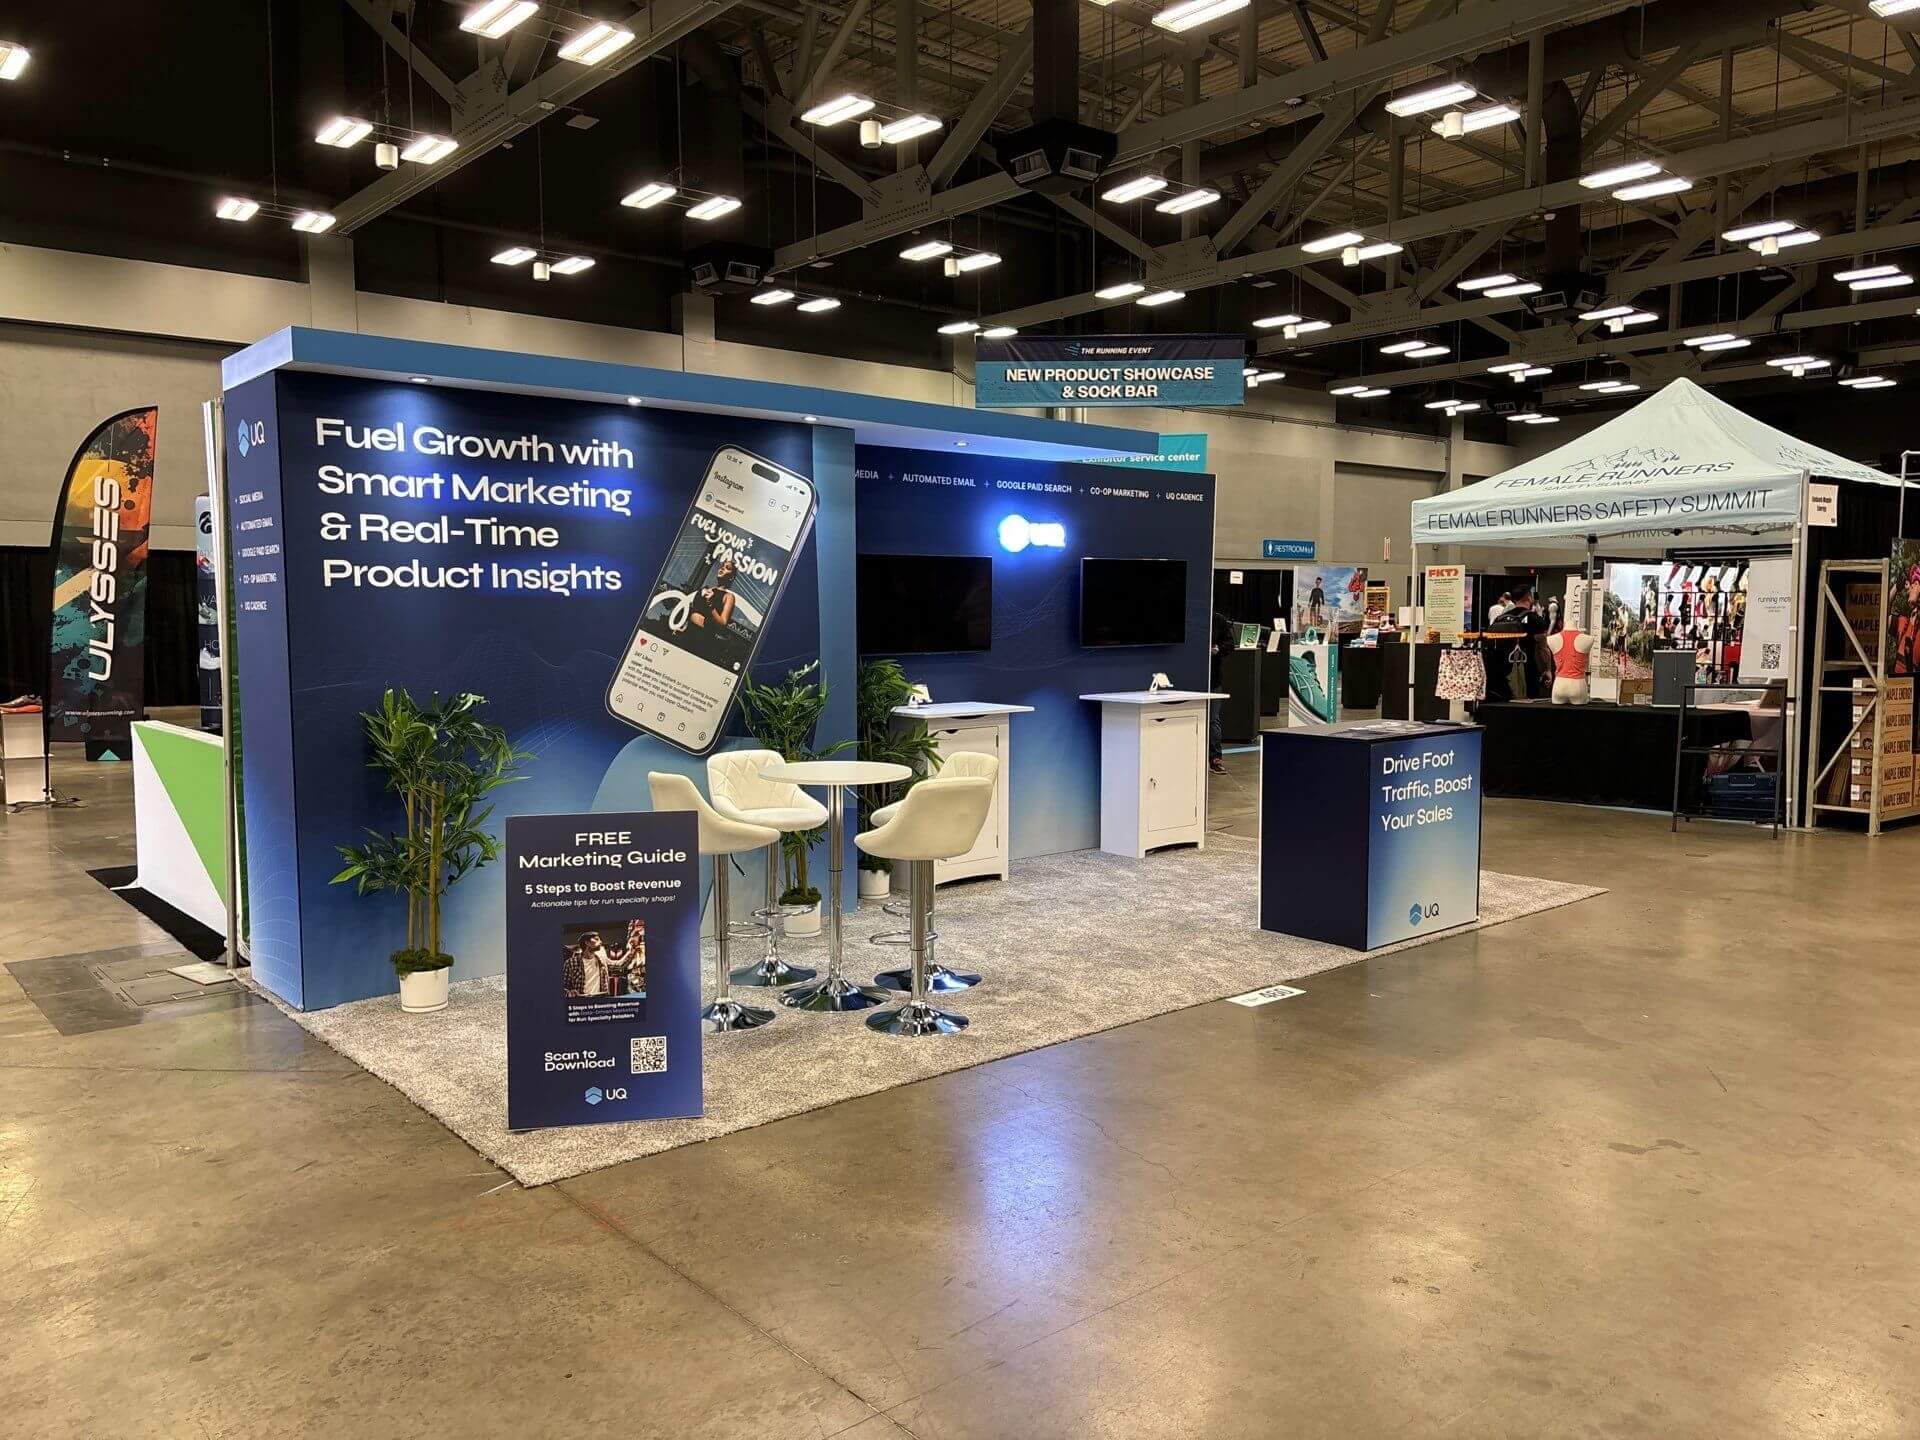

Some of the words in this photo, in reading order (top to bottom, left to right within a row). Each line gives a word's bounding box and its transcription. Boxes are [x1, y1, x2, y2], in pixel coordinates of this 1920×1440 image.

[1006, 369, 1043, 382] NEW
[1044, 368, 1120, 381] PRODUCT
[1123, 367, 1214, 380] SHOWCASE
[1063, 386, 1074, 398] &
[1077, 385, 1122, 398] SOCK
[1125, 385, 1158, 397] BAR
[250, 420, 266, 447] UQ
[316, 417, 405, 453] Fuel
[413, 426, 554, 463] Growth
[560, 438, 633, 469] with
[1167, 453, 1200, 462] center
[902, 473, 952, 485] AUTOMATED
[953, 477, 976, 487] EMAIL
[1494, 472, 1596, 489] FEMALE
[1597, 462, 1735, 482] RUNNERS
[317, 465, 445, 500] Smart
[453, 475, 632, 516] Marketing
[996, 480, 1026, 490] GOOGLE
[1027, 482, 1044, 491] PAID
[1044, 484, 1072, 493] SEARCH
[1090, 486, 1112, 495] CO-OP
[1113, 488, 1149, 498] MARKETING
[1166, 493, 1175, 501] UQ
[1176, 492, 1204, 501] CADENCE
[1427, 508, 1499, 530] FEMALE
[1501, 504, 1592, 526] RUNNERS
[1595, 498, 1676, 519] SAFETY
[1680, 489, 1773, 514] SUMMIT
[320, 512, 352, 541] &
[361, 514, 559, 548] Real-Time
[718, 528, 747, 551] YOUR
[712, 543, 778, 586] PASSION
[88, 476, 120, 682] ULYSSES
[324, 559, 484, 589] Product
[492, 562, 622, 597] Insights
[1383, 755, 1419, 775] Drive
[1423, 750, 1455, 770] Foot
[1382, 780, 1432, 803] Traffic,
[1434, 774, 1472, 794] Boost
[1382, 814, 1414, 832] Your
[1416, 805, 1453, 826] Sales
[575, 831, 631, 847] FREE
[519, 850, 622, 869] Marketing
[627, 848, 687, 864] Guide
[525, 884, 532, 895] 5
[536, 883, 572, 897] Steps
[574, 882, 587, 892] to
[590, 879, 625, 892] Boost
[628, 877, 681, 891] Revenue
[531, 899, 572, 909] Actionable
[573, 898, 588, 908] tips
[589, 897, 600, 906] for
[616, 895, 649, 906] specialty
[651, 894, 676, 904] shops!
[1424, 902, 1440, 919] UQ
[544, 1050, 579, 1063] Scan
[581, 1049, 597, 1061] to
[544, 1056, 615, 1072] Download
[606, 1087, 628, 1101] UQ
